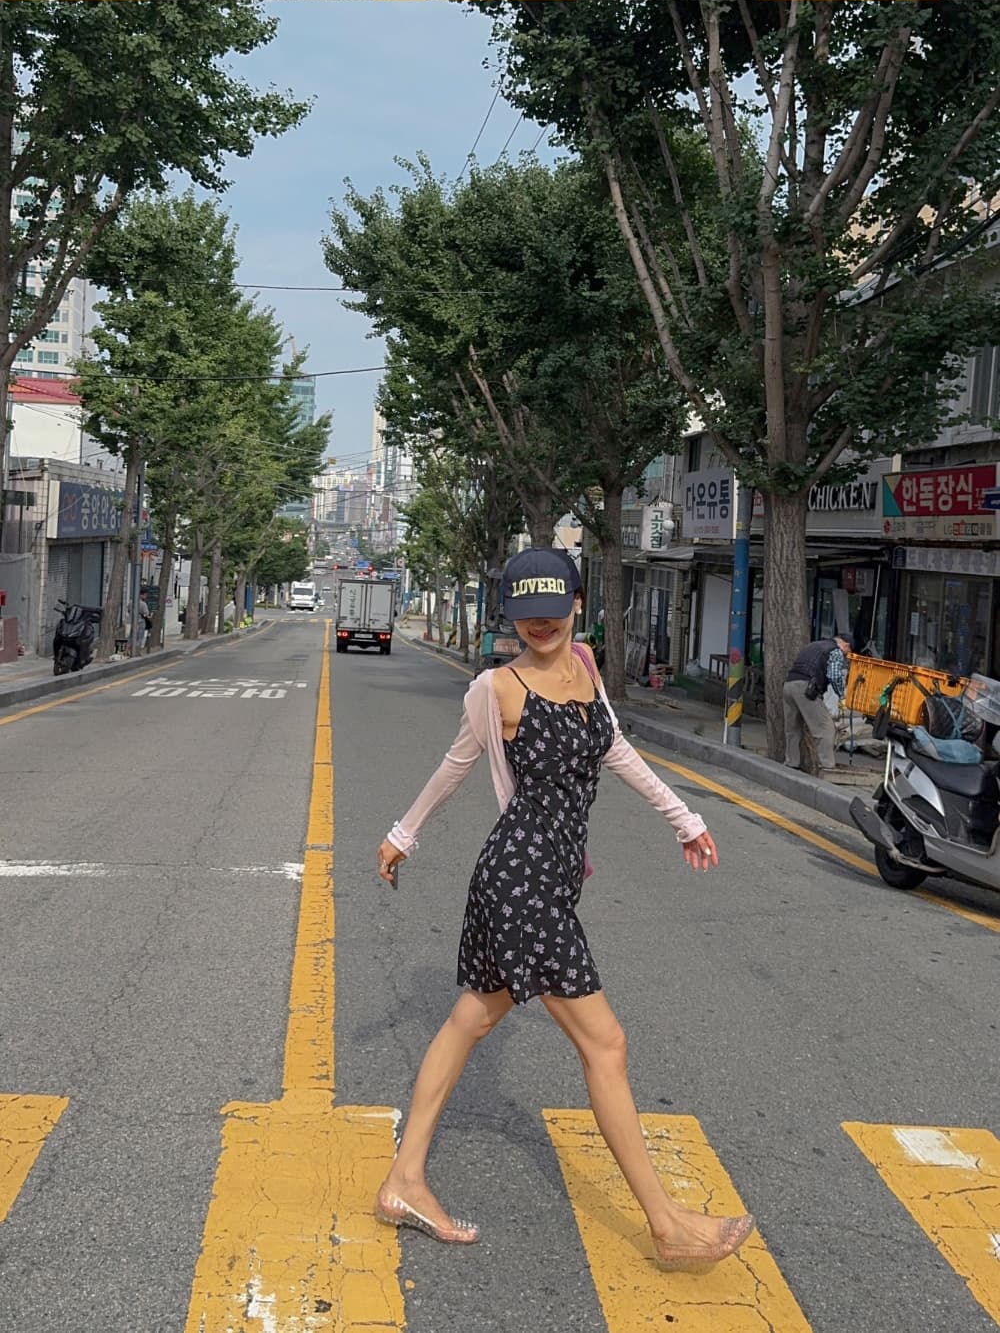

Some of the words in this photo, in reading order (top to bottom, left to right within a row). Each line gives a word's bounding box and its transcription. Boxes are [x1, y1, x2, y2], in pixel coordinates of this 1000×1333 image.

[686, 479, 730, 520] 다온유통
[808, 481, 874, 511] CHICKEN
[902, 473, 973, 512] 한독장식
[650, 509, 664, 548] 고깃집
[512, 577, 566, 598] LOVERO
